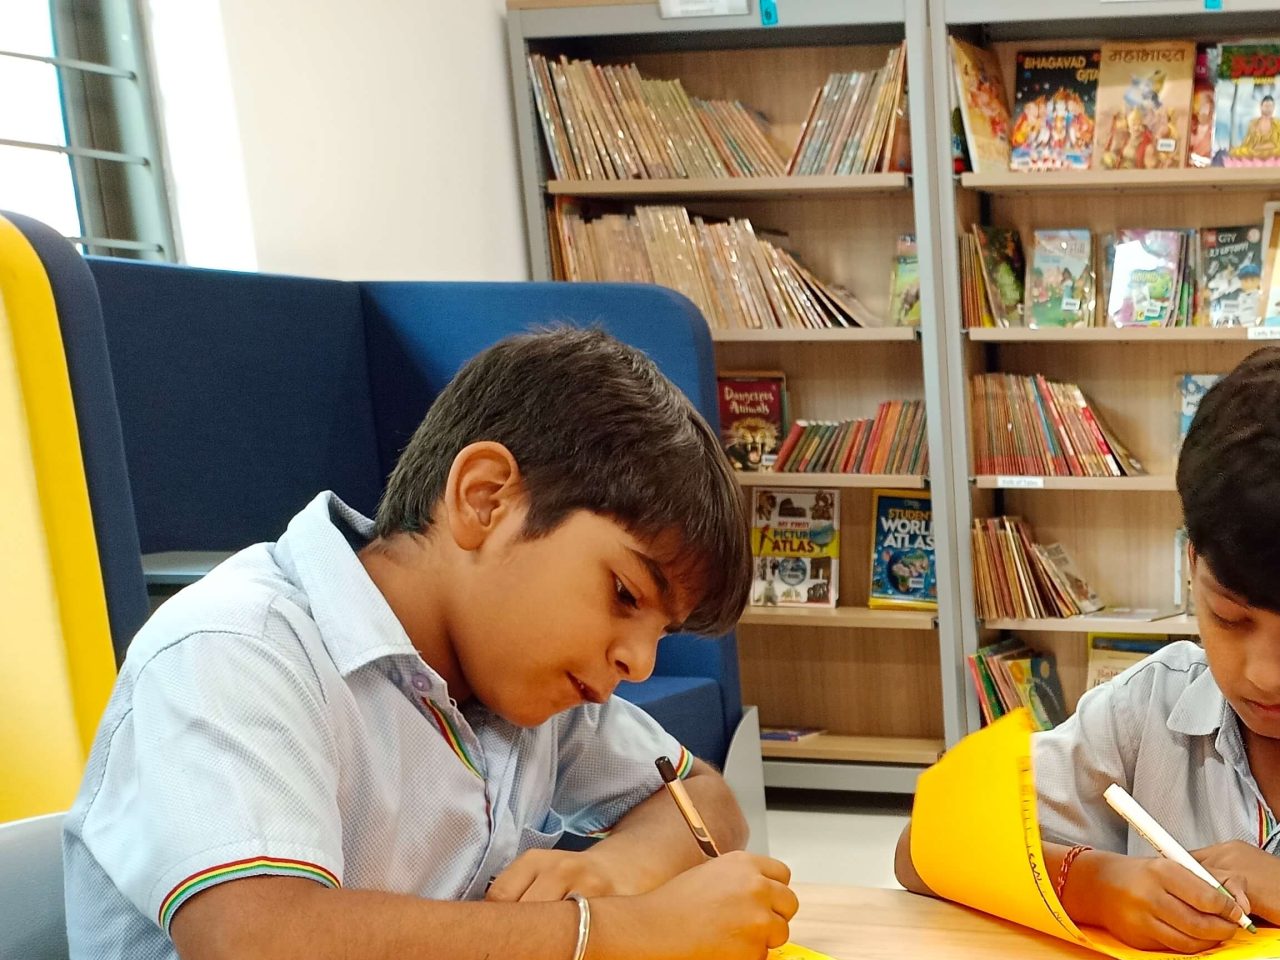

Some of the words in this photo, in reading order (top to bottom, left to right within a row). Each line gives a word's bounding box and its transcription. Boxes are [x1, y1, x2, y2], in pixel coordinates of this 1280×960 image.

[1107, 46, 1186, 64] महाभारत
[1023, 56, 1086, 71] BHAGAVAD
[723, 385, 775, 405] Dangerous
[729, 400, 770, 415] Animals
[881, 516, 934, 535] WORL
[772, 539, 815, 553] ATLAS
[883, 535, 935, 550] ATLAS
